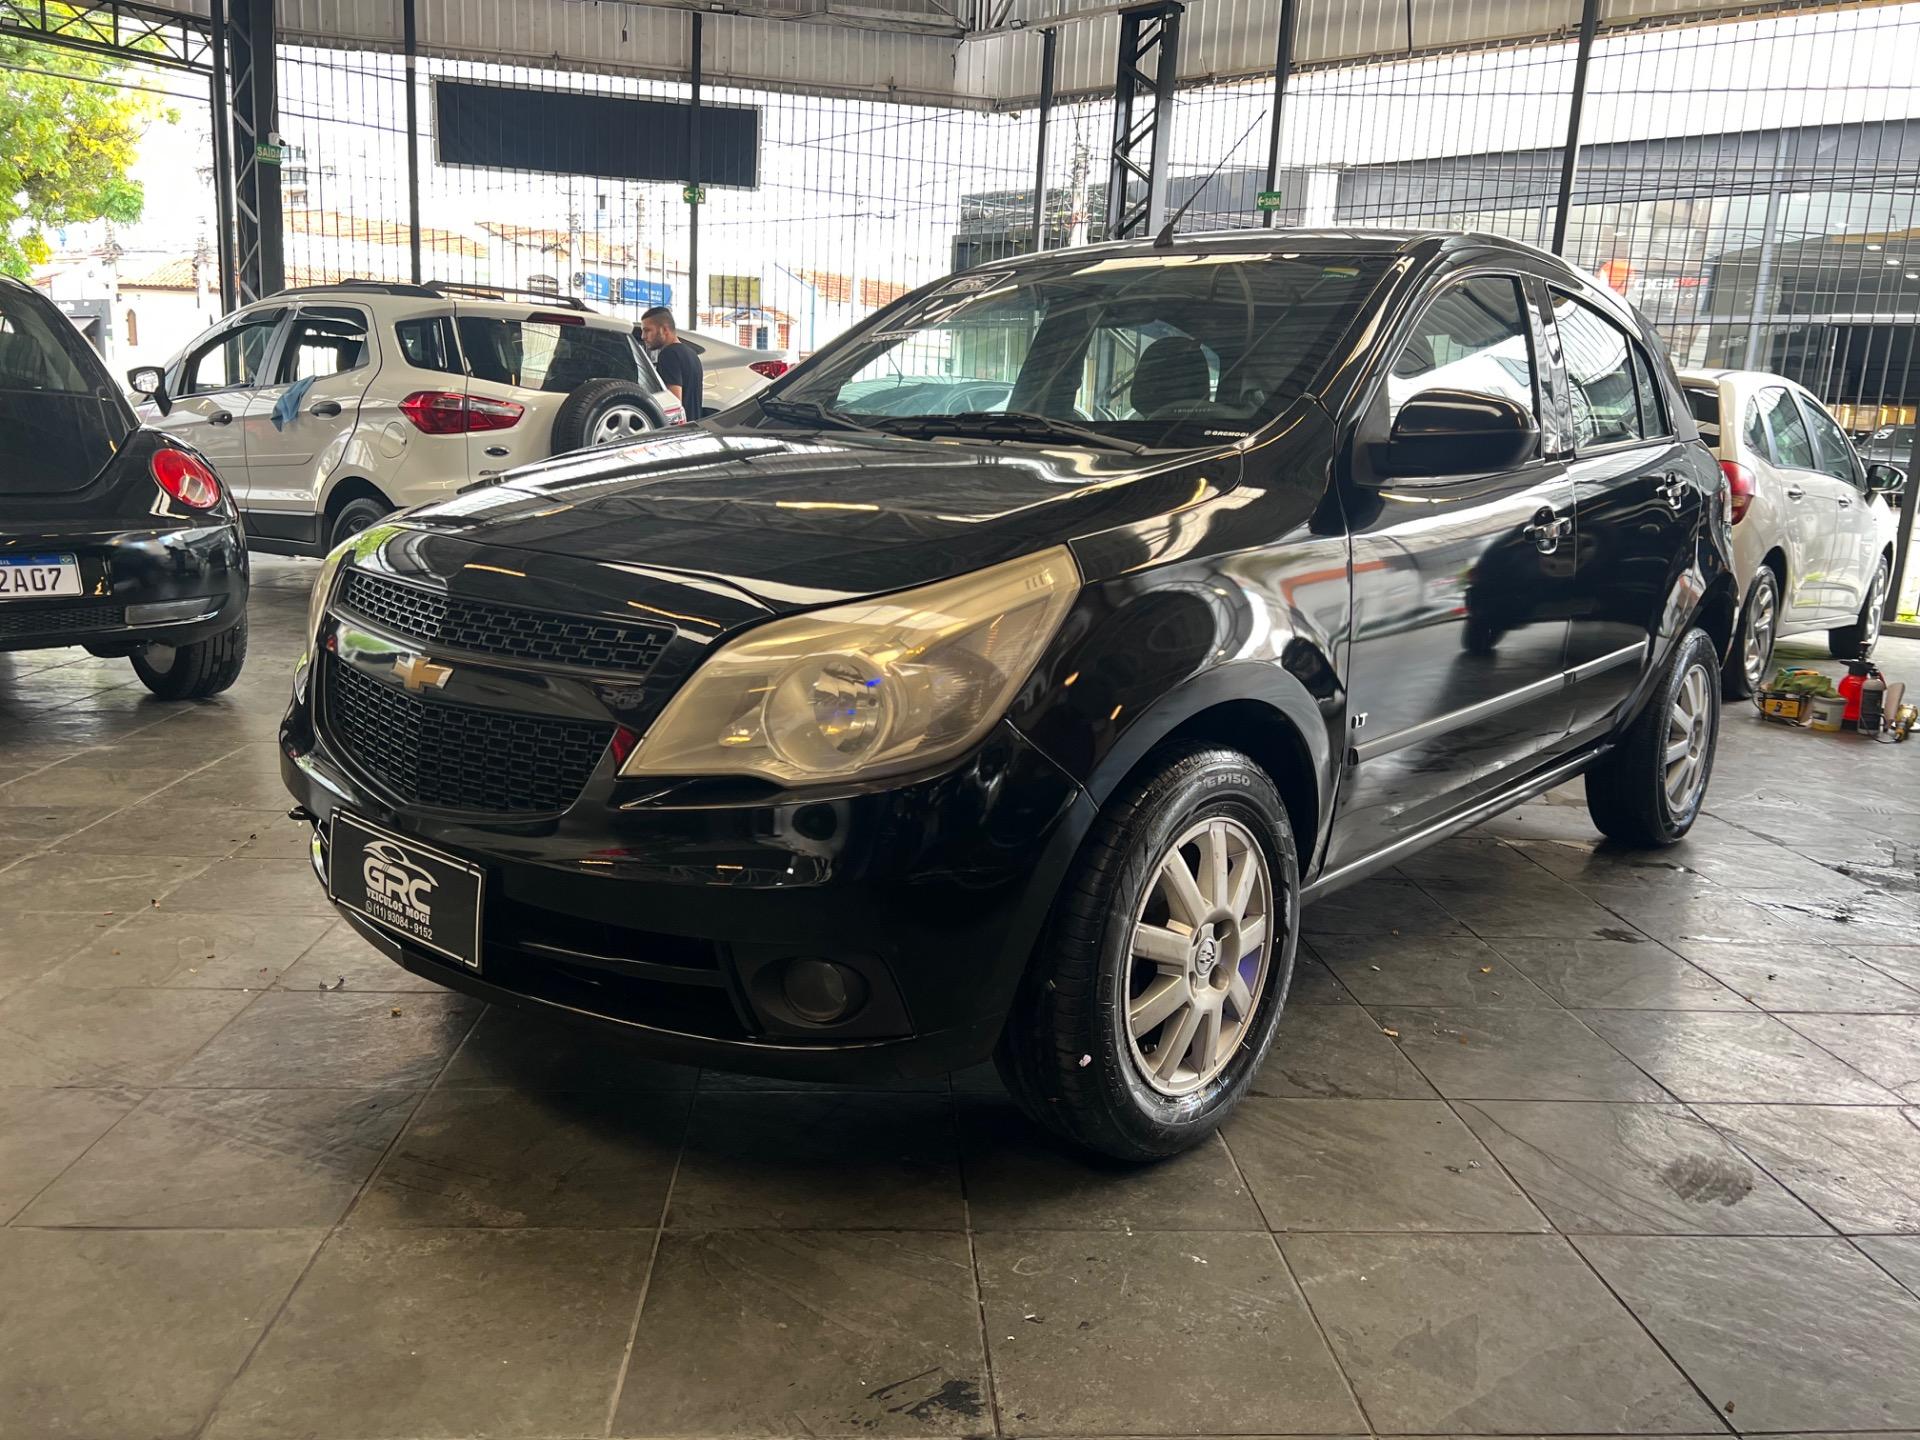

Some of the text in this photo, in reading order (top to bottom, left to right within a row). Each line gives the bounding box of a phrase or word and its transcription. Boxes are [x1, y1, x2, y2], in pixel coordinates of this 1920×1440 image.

[1206, 772, 1251, 788] EP150
[363, 857, 432, 914] GRC
[366, 888, 431, 926] VEICULOS MOGI
[373, 903, 387, 920] (11)
[387, 910, 409, 930] 93084
[414, 924, 433, 940] 9152
